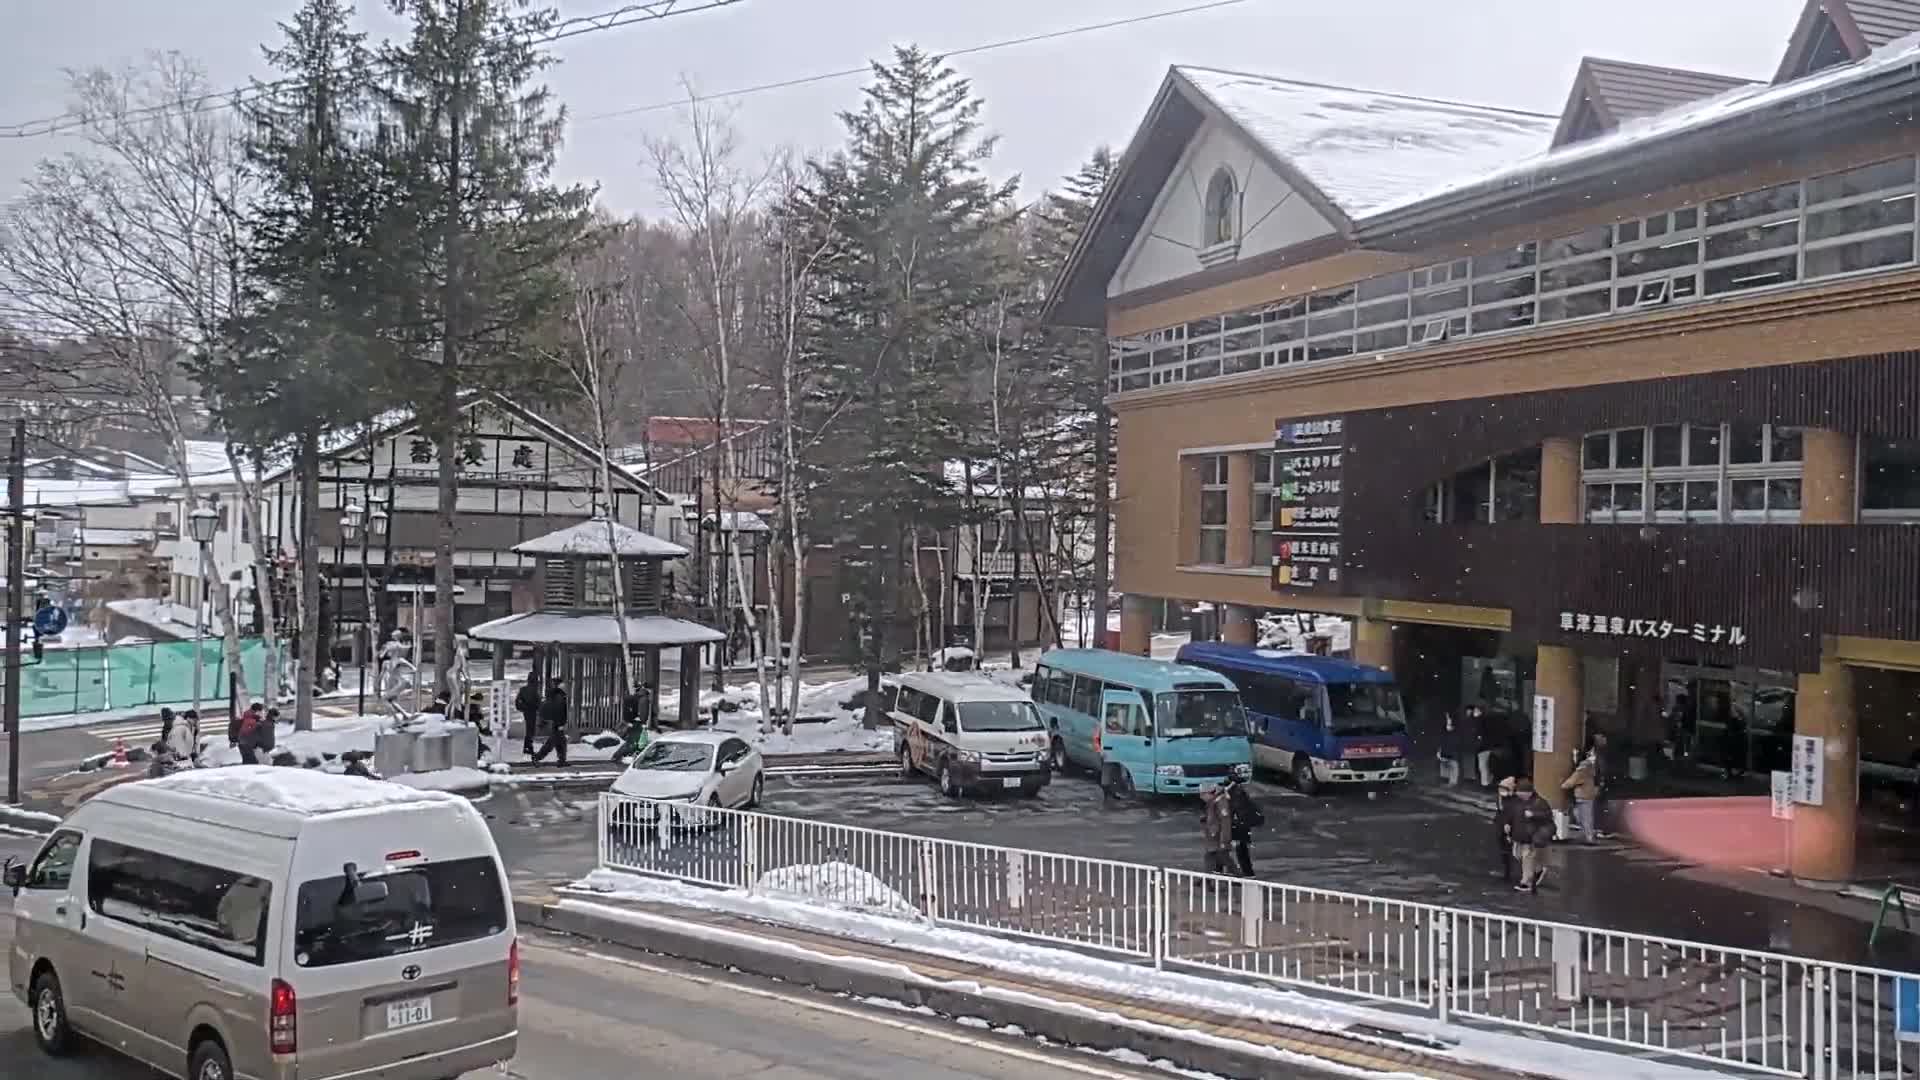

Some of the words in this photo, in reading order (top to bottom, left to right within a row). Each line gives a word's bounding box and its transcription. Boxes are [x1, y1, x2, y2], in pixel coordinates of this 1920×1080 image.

[1559, 612, 1746, 646] 草津温泉バスターミナル
